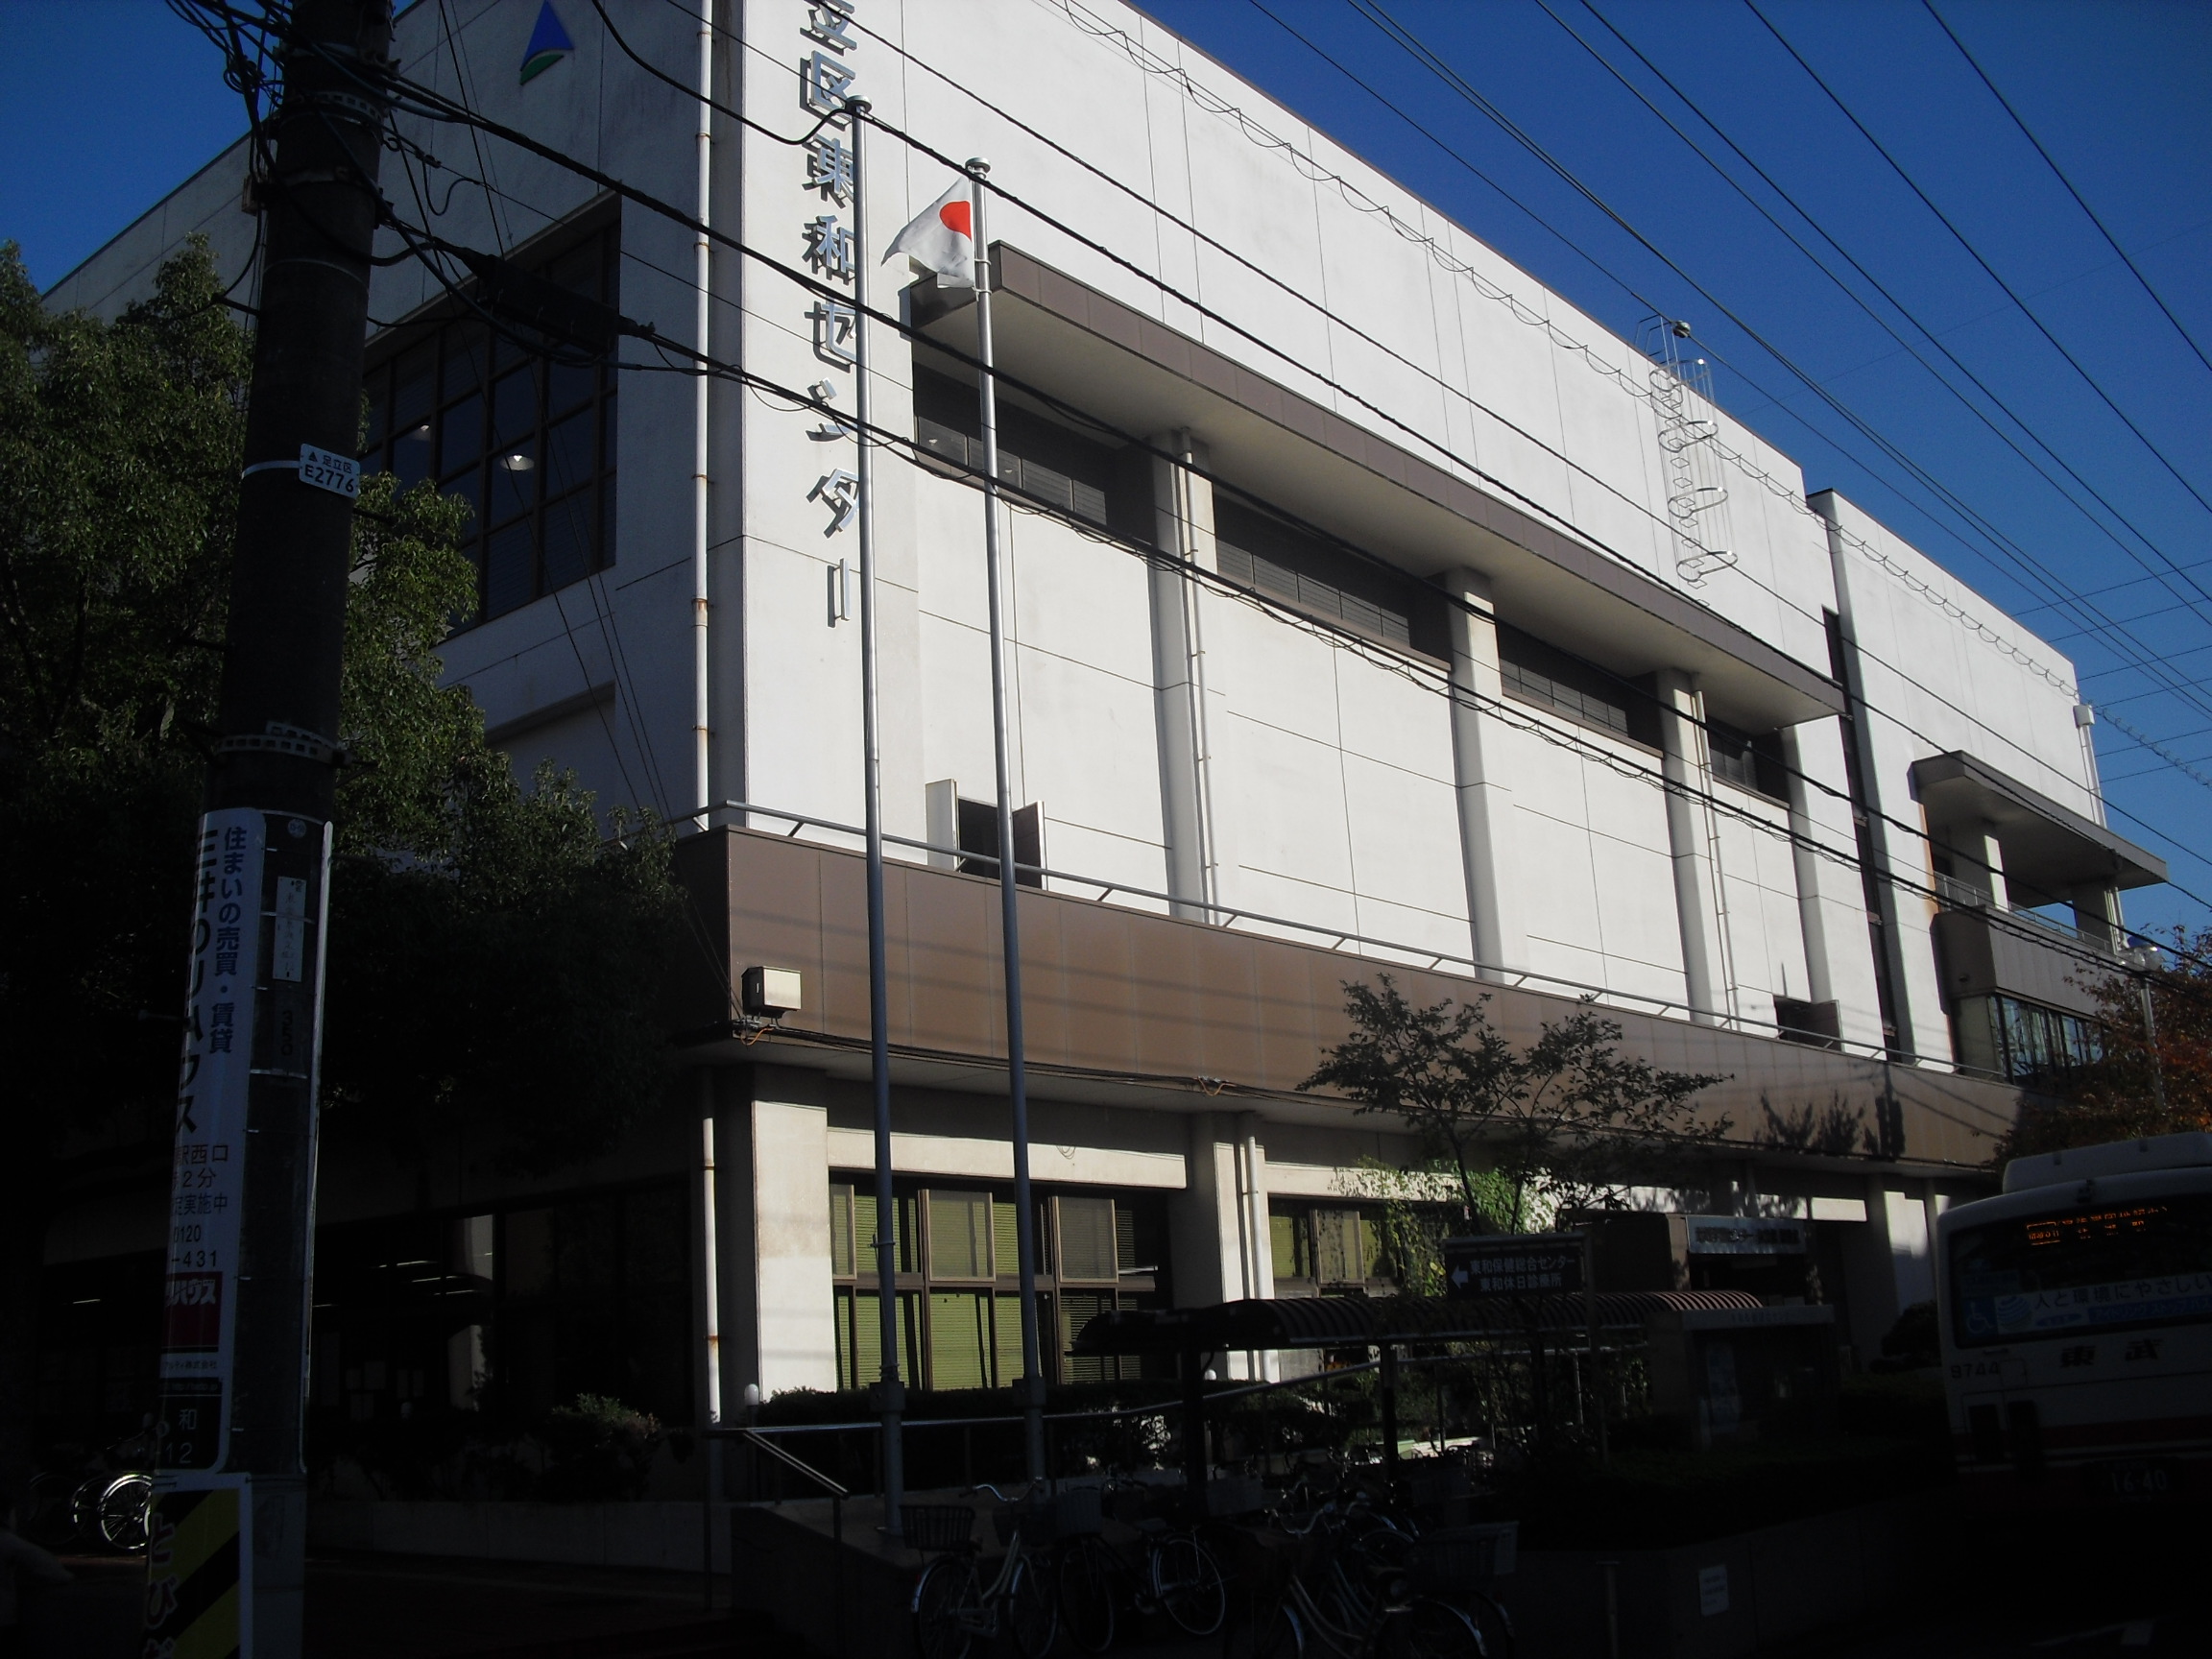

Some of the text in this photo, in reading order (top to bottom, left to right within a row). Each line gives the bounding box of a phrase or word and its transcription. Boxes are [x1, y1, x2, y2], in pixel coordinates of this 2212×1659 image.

[323, 455, 351, 473] 足立区
[304, 465, 354, 493] E2776
[209, 827, 247, 1053] 住まいの売買・賃貸
[1470, 1255, 1575, 1275] 東和保健総合センター
[1480, 1272, 1562, 1292] 東和休日診療所
